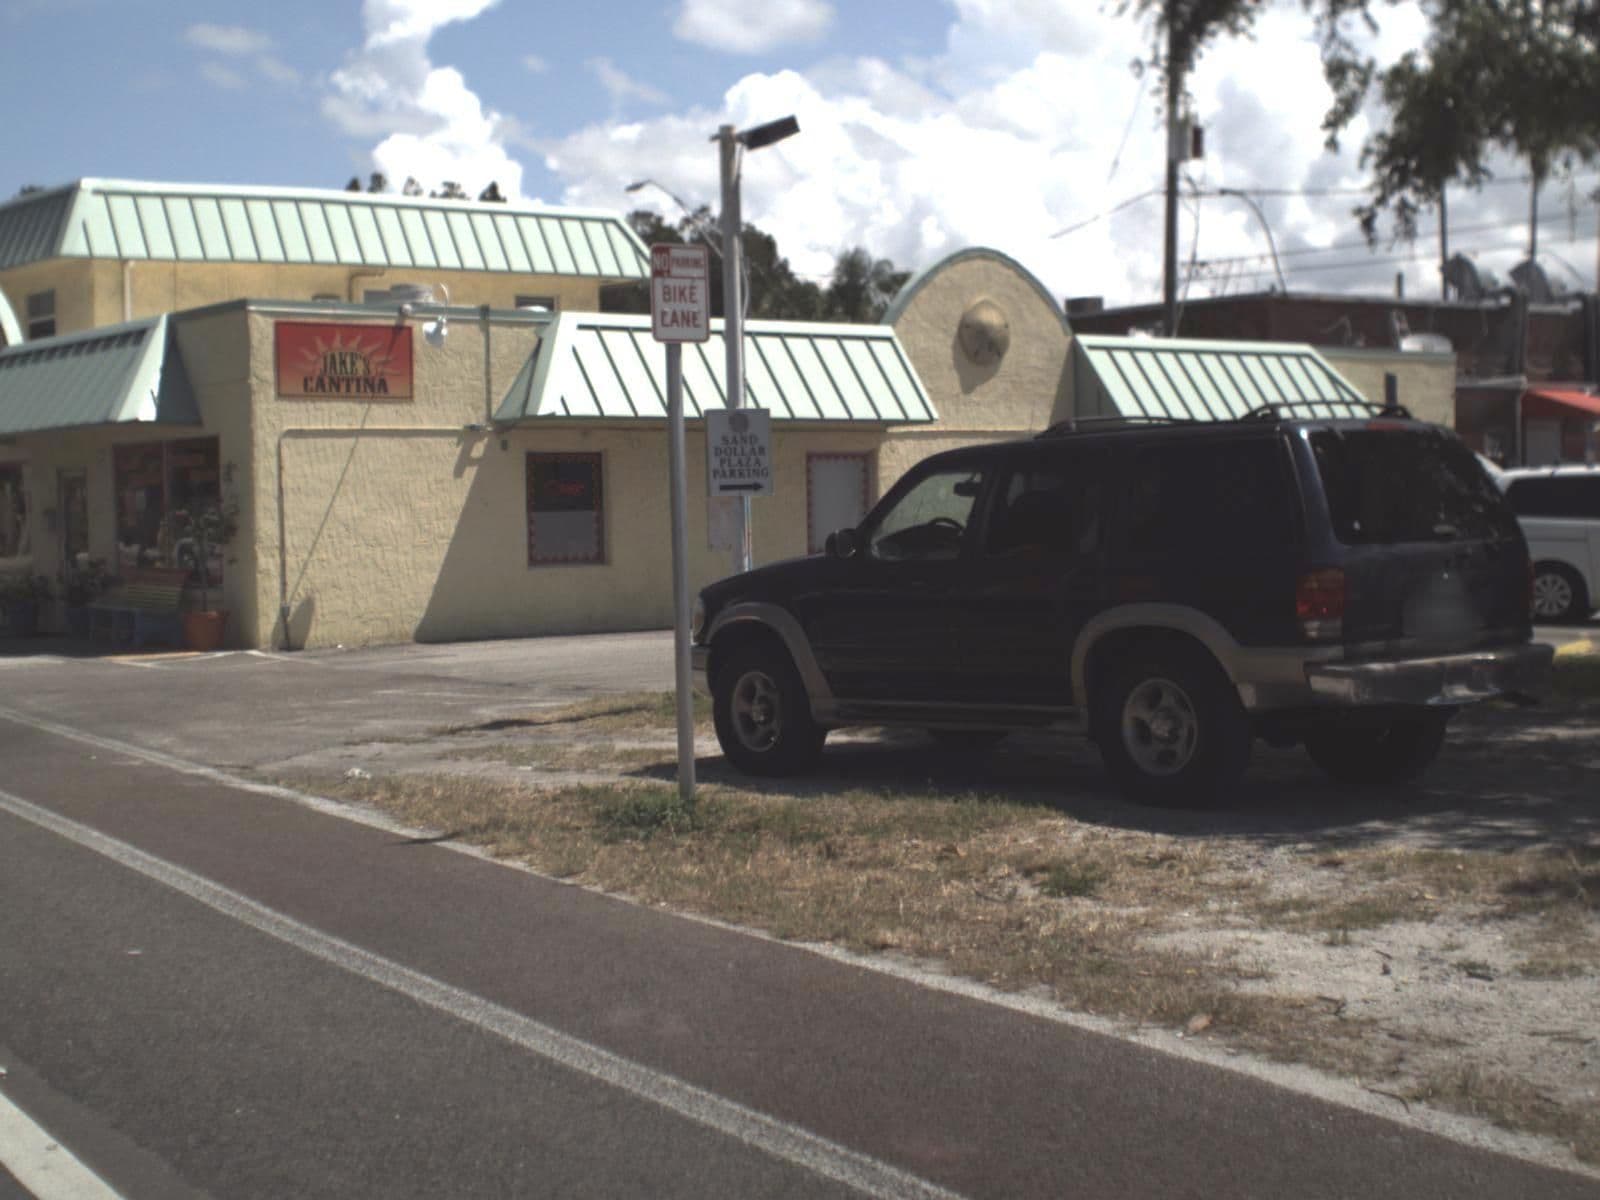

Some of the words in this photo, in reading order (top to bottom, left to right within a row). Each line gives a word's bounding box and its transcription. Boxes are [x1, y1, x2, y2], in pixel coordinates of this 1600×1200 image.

[653, 252, 671, 270] NO
[662, 285, 698, 304] BIKE
[661, 309, 700, 328] LANE
[303, 376, 389, 394] CANTINA
[714, 446, 766, 457] DOLLAR
[720, 457, 762, 468] PLAZA
[713, 468, 769, 479] PARKING
